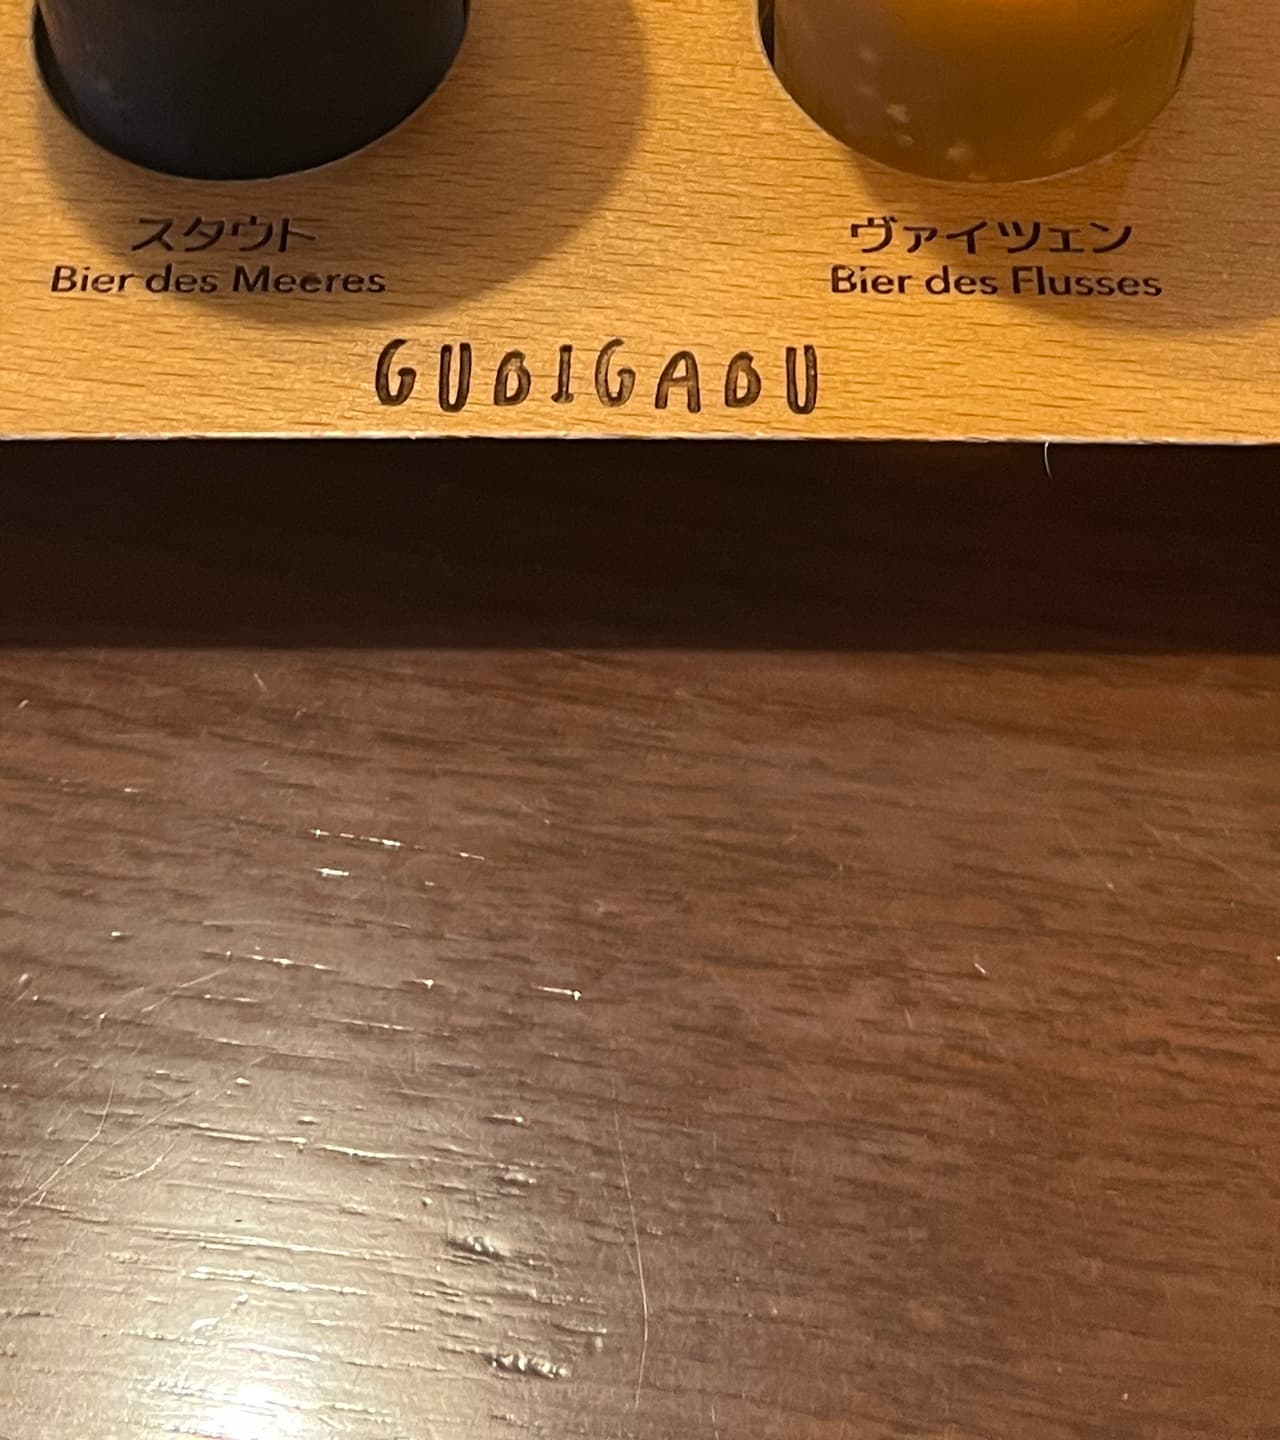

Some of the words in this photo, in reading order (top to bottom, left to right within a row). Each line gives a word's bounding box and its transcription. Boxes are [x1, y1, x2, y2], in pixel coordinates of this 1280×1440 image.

[131, 215, 317, 253] スタウト
[850, 216, 1133, 254] ヴァイツェン
[51, 264, 134, 293] Bier
[145, 263, 218, 293] des
[232, 264, 386, 293] Meeres
[830, 265, 912, 294] Bier
[924, 265, 999, 295] des
[1012, 265, 1162, 296] Flusses
